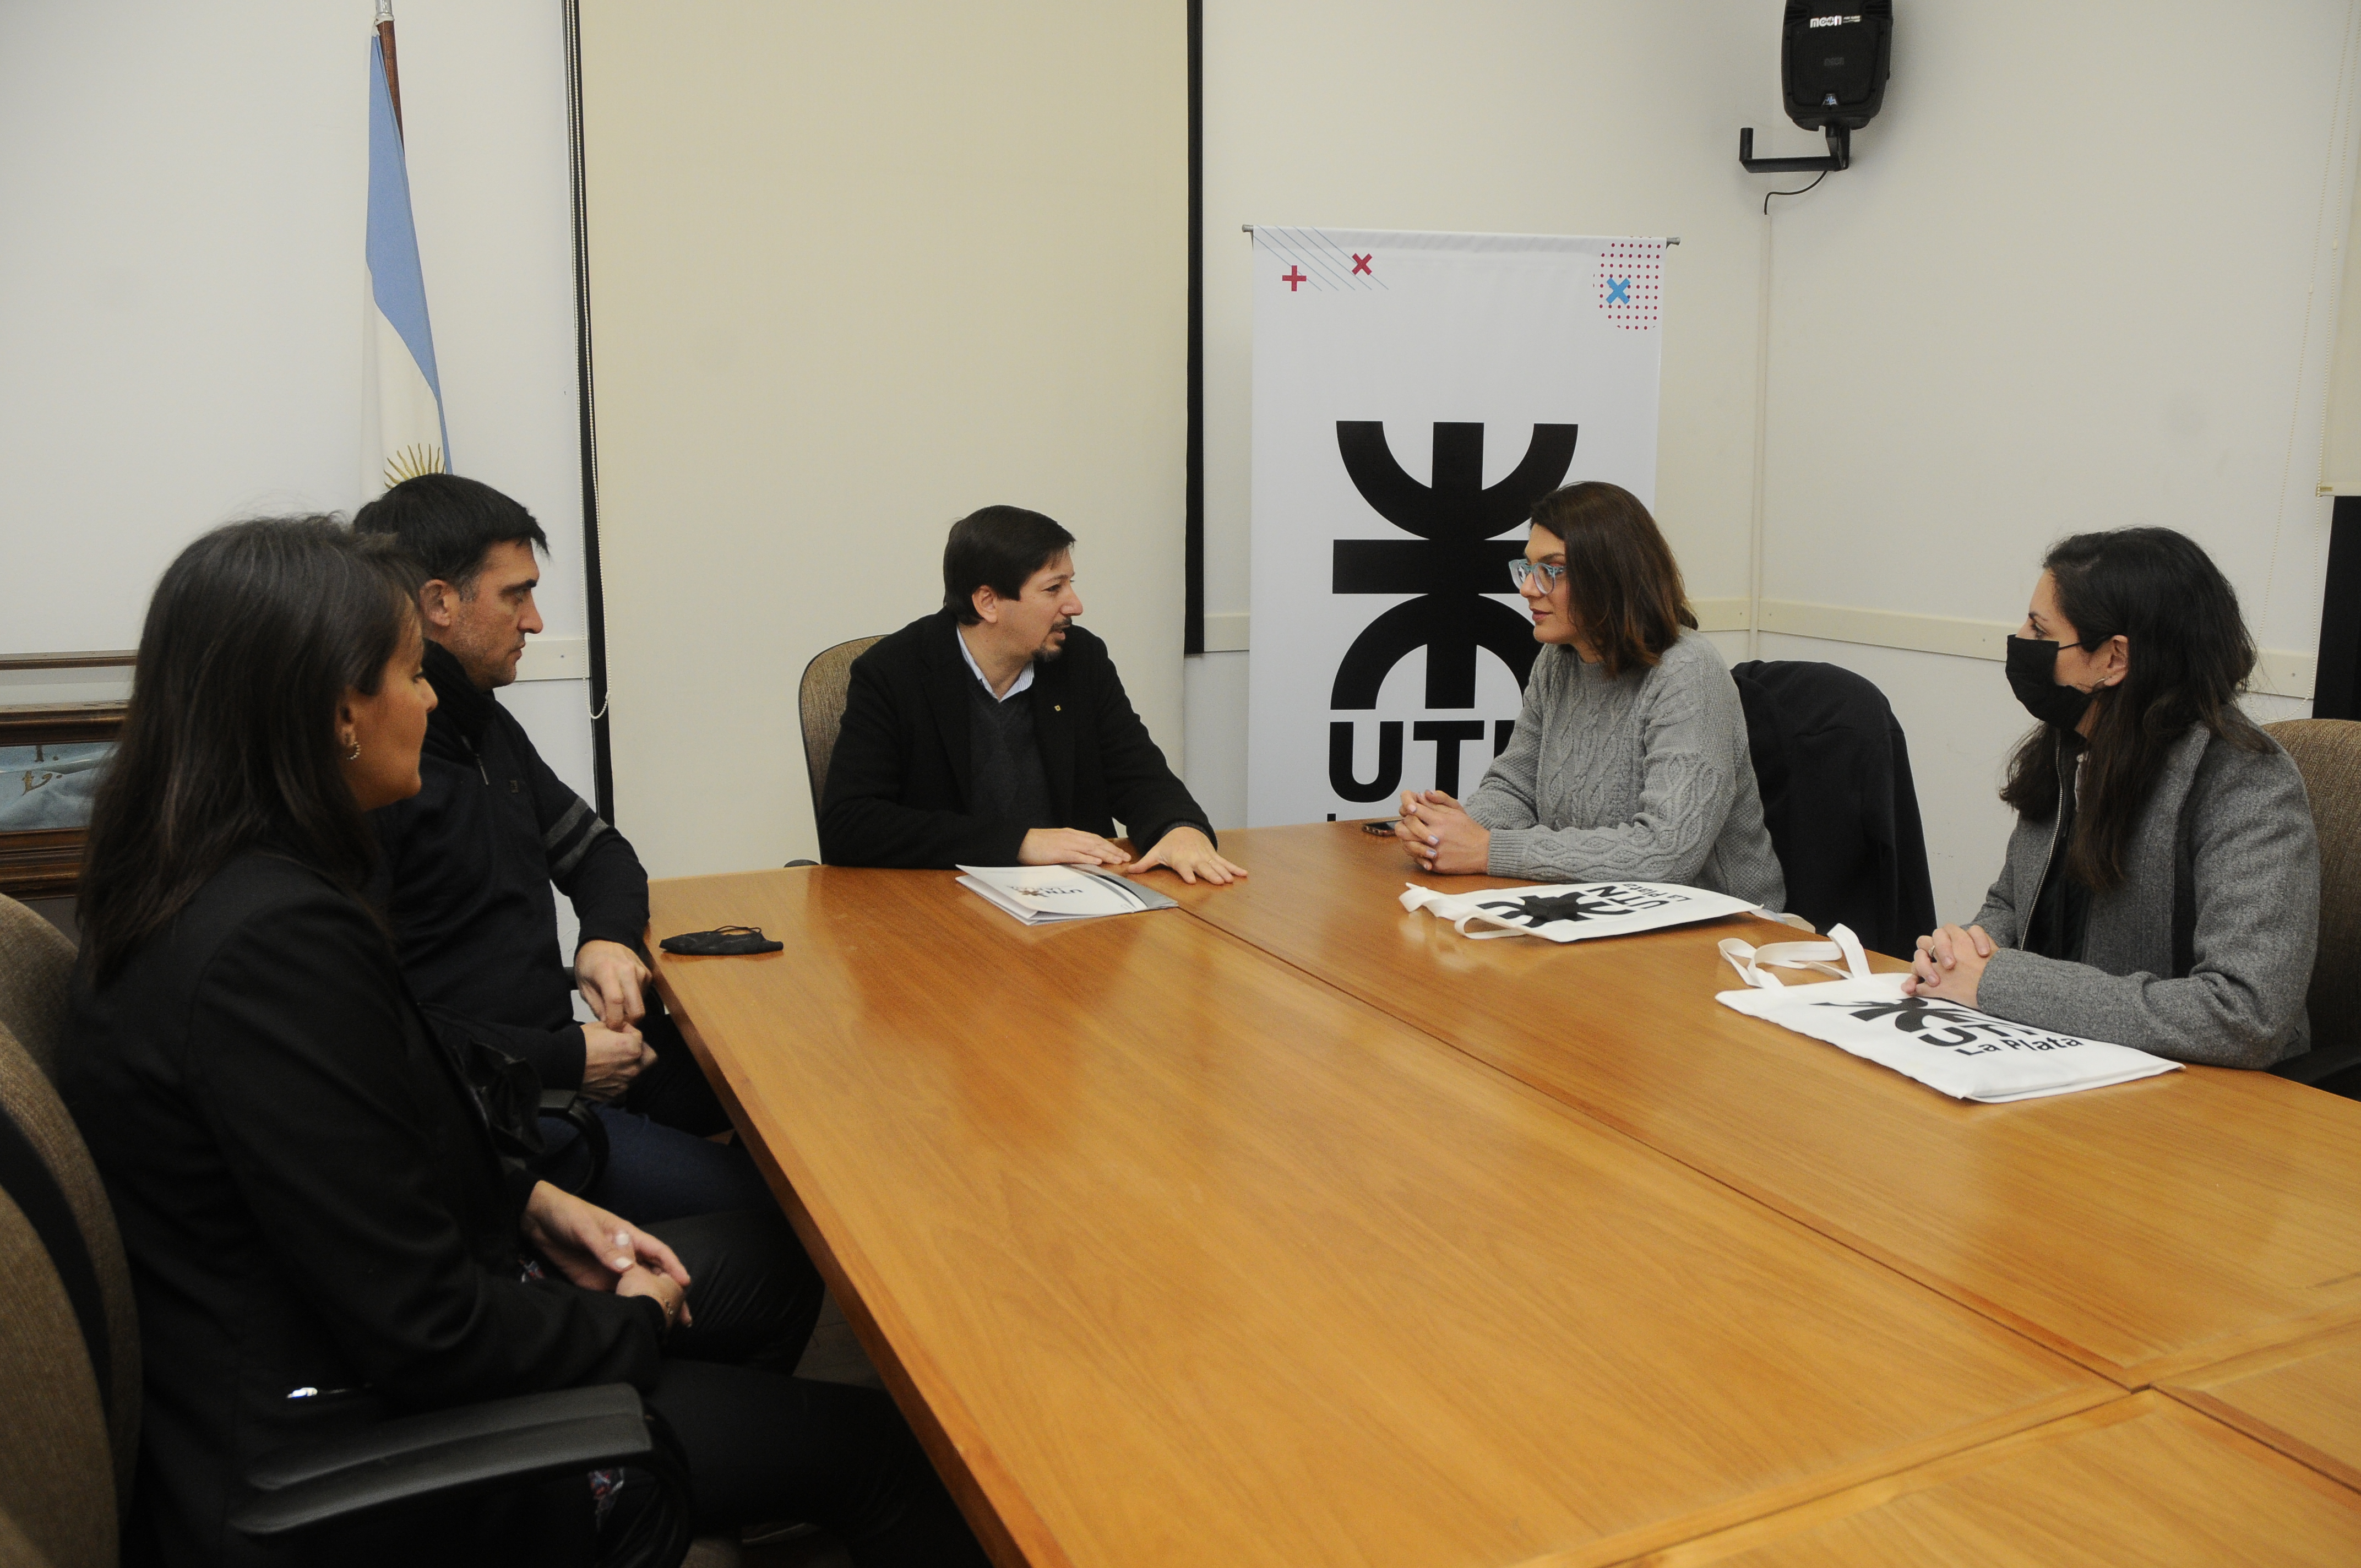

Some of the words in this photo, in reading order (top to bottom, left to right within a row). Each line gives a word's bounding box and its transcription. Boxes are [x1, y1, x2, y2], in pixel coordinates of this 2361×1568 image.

[1810, 15, 1842, 28] moon
[1585, 885, 1670, 910] UTN
[1622, 883, 1668, 897] Plata
[1955, 1043, 2002, 1056] La
[1999, 1037, 2085, 1052] Plata
